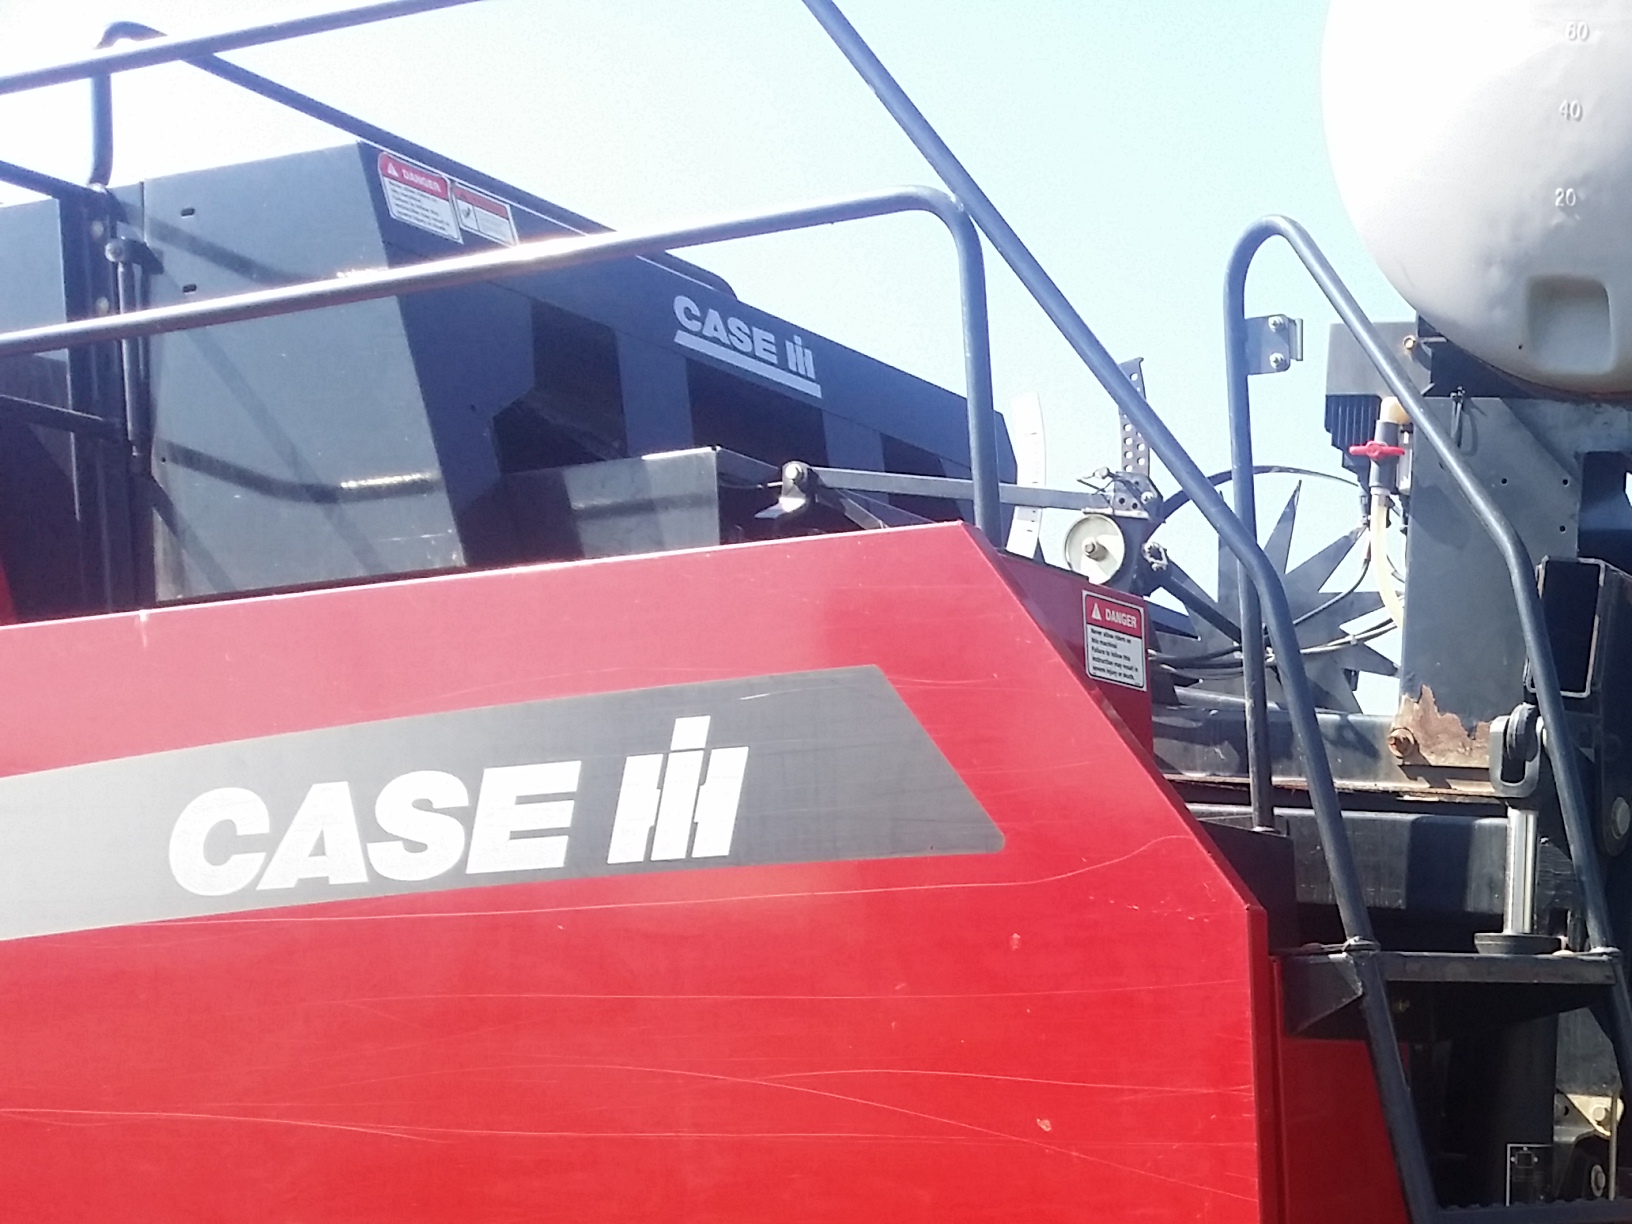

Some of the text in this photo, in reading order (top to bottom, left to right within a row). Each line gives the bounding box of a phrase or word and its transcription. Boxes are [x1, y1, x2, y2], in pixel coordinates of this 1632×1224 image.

[1566, 21, 1590, 42] 60
[1558, 100, 1583, 122] 40
[401, 168, 443, 193] DANGER
[1554, 187, 1577, 208] 20
[673, 294, 779, 365] CASE
[1105, 608, 1137, 628] DANGER
[167, 759, 582, 898] CASE
